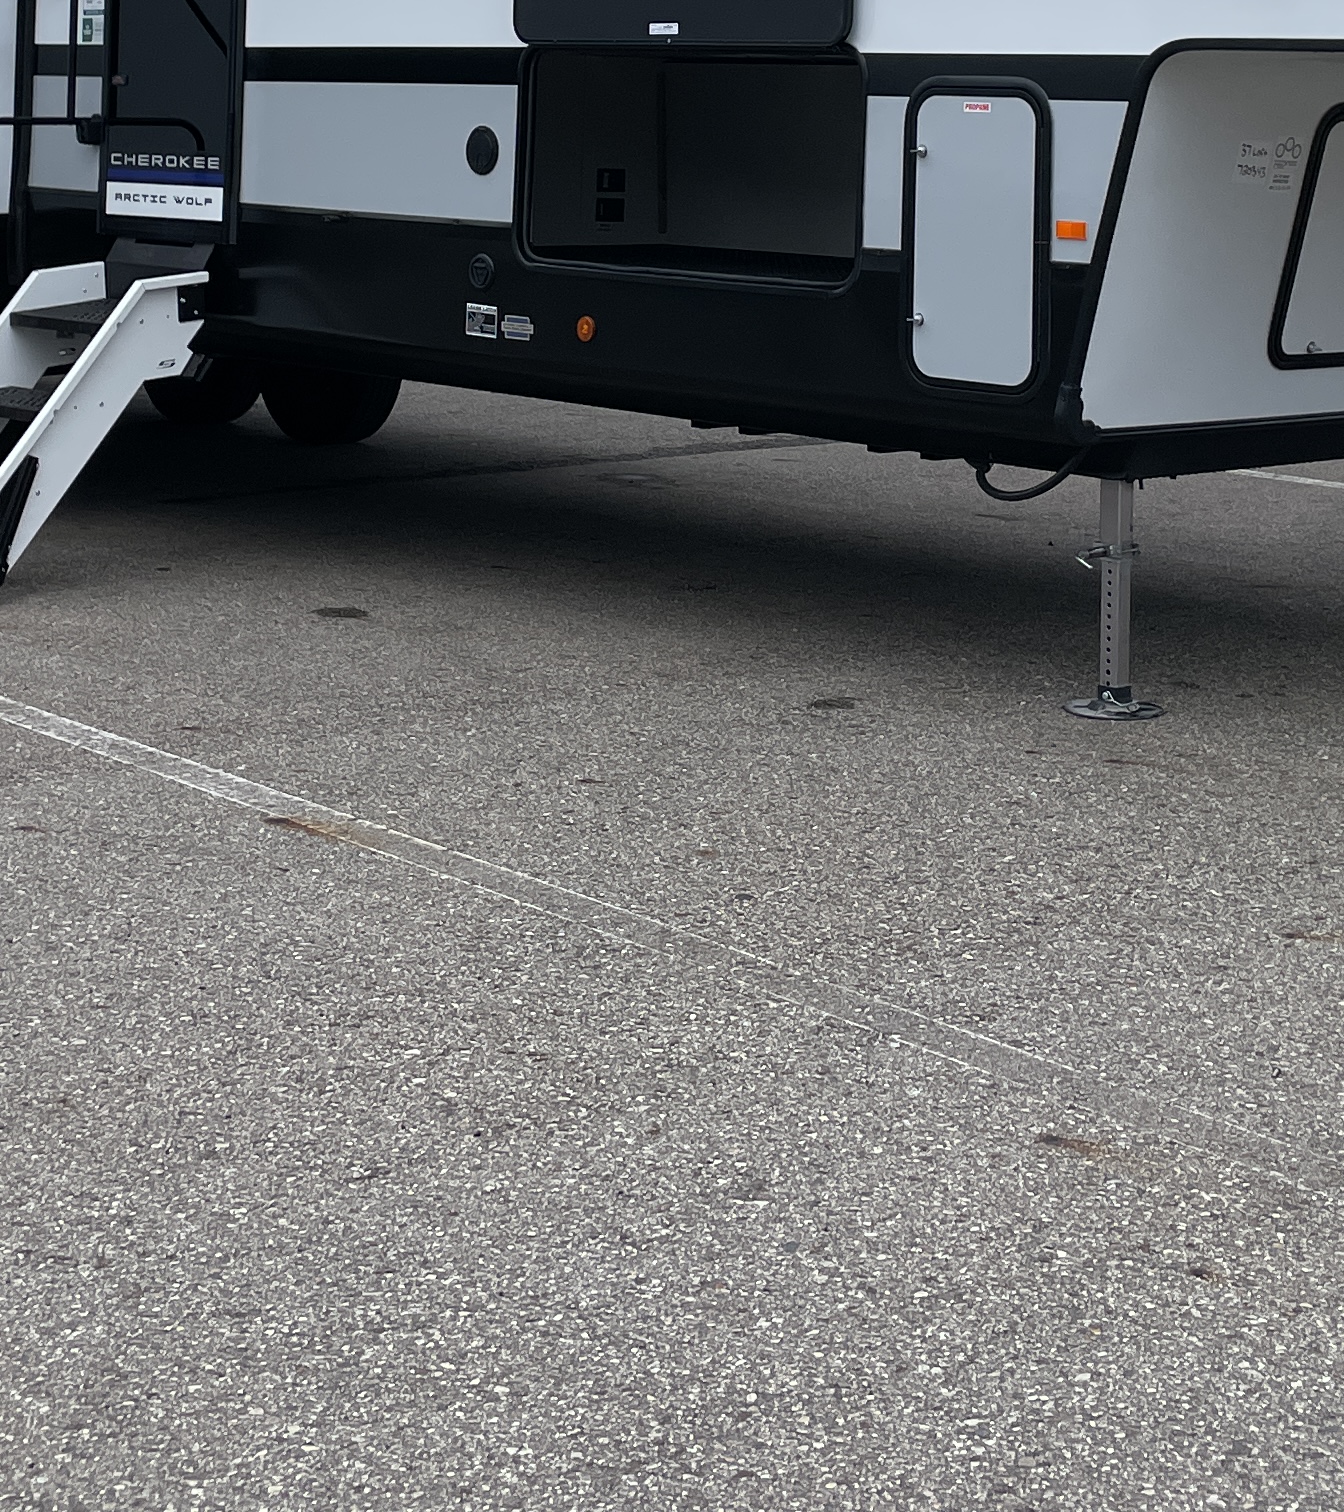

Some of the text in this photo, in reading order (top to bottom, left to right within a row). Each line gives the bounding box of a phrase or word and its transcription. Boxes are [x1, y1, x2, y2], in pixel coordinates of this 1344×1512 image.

[110, 152, 220, 170] CHEROKEE
[114, 192, 213, 207] ARCTIC WOLF
